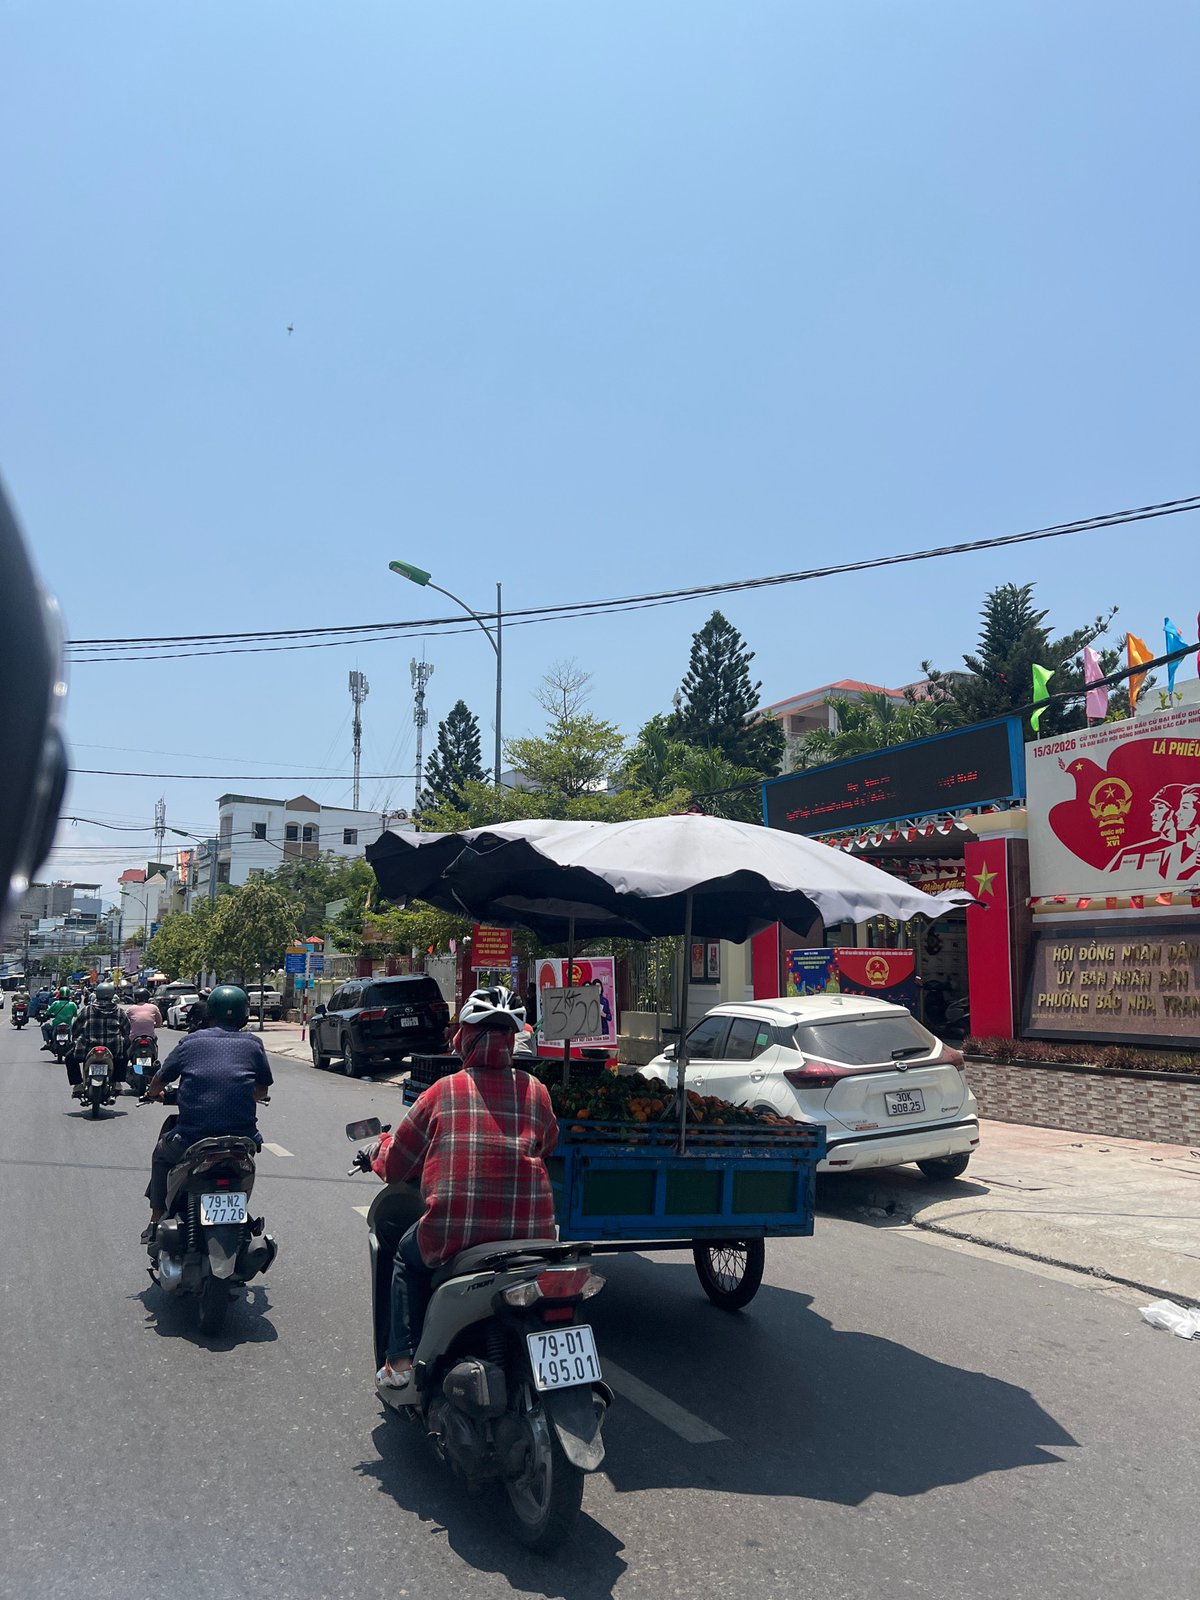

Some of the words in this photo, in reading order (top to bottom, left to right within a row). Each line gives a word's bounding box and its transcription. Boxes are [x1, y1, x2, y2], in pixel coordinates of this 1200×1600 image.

[1033, 738, 1076, 758] 15/3/2026
[1152, 739, 1166, 755] LÁ
[1169, 740, 1200, 757] PHIẾU
[1106, 839, 1120, 847] XVI
[1052, 945, 1074, 965] HỘI
[1079, 940, 1115, 961] ĐỒNG
[1168, 940, 1200, 961] DÂN
[1056, 966, 1073, 985] ỦY
[1080, 970, 1106, 985] BAN
[1112, 968, 1151, 986] NHÂN
[1037, 990, 1089, 1008] PHƯỜNG
[1095, 988, 1122, 1009] BẮC
[1128, 995, 1156, 1010] NHA
[896, 1092, 913, 1102] 30K
[891, 1102, 921, 1113] 908.25
[209, 1195, 240, 1208] 79-N2
[205, 1208, 245, 1222] 477.26
[538, 1354, 597, 1385] 495.01
